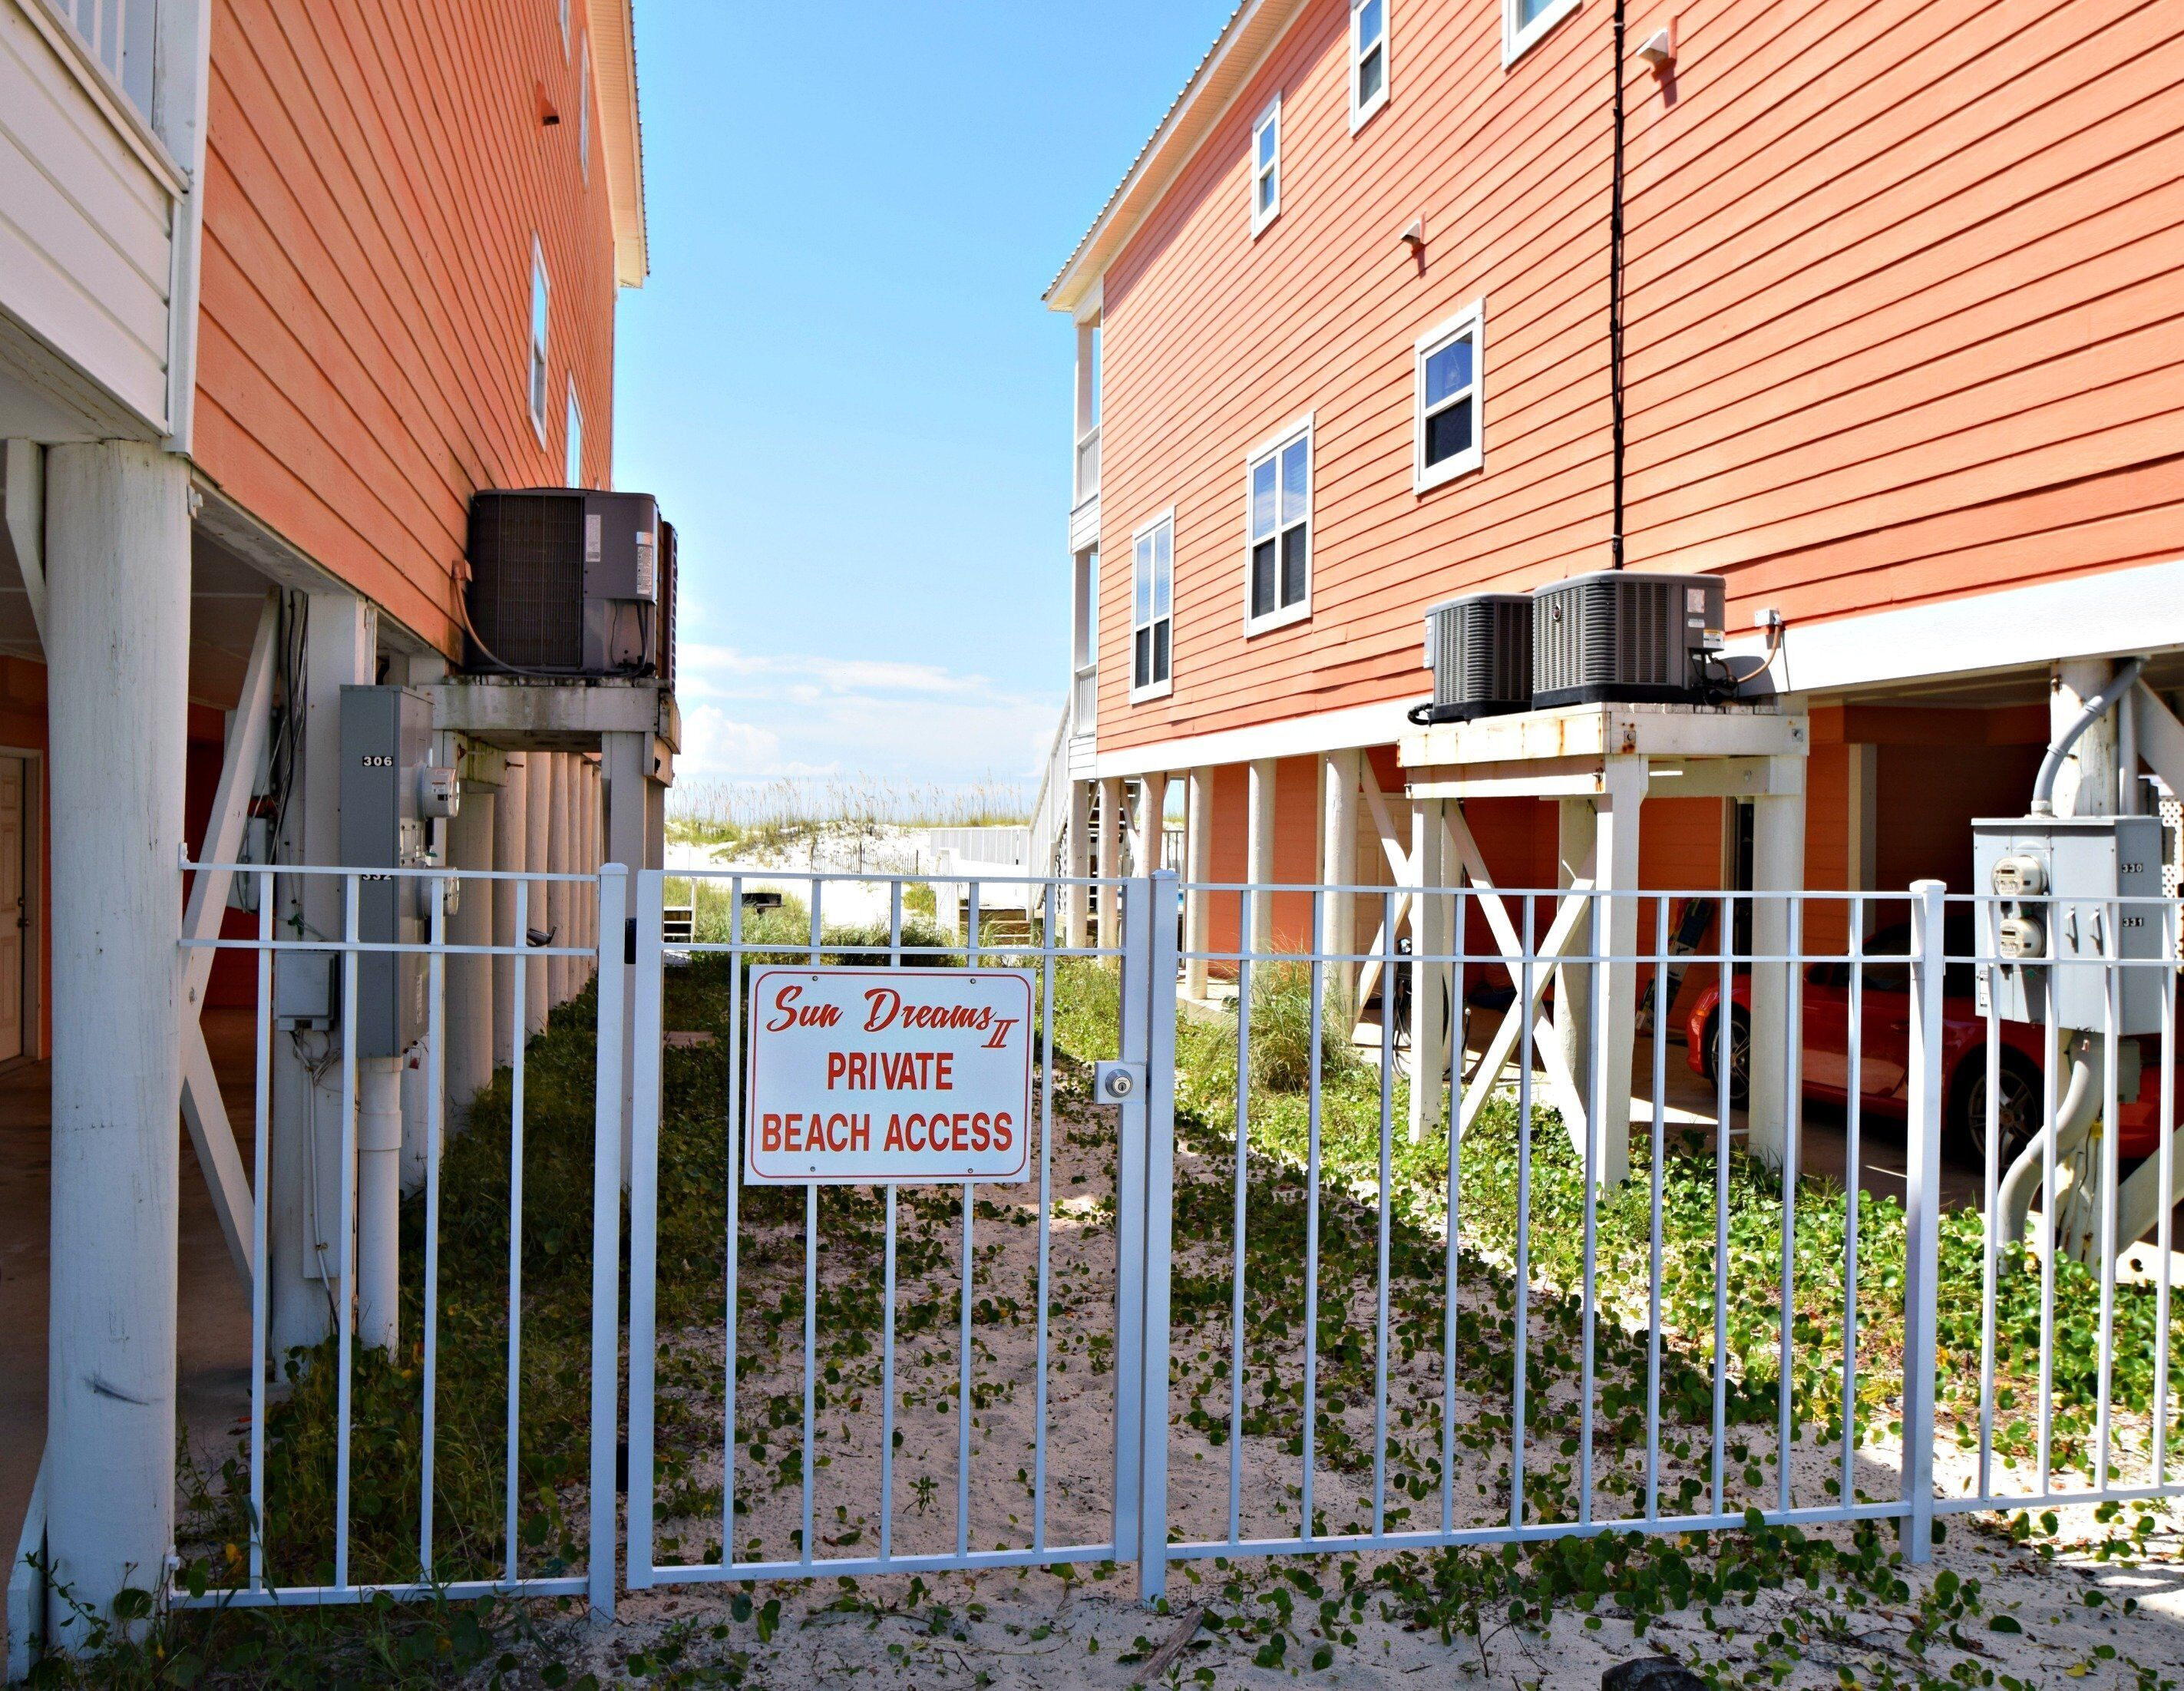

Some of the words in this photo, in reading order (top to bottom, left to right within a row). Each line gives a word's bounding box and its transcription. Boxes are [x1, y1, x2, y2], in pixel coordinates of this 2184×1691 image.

[363, 756, 392, 767] 306
[2122, 864, 2143, 874] 330
[2123, 917, 2143, 926] 331
[766, 985, 844, 1032] Sun
[864, 988, 997, 1033] Dreams
[828, 1052, 954, 1090] PRIVATE
[762, 1113, 871, 1152] BEACH
[883, 1111, 1013, 1152] ACCESS
